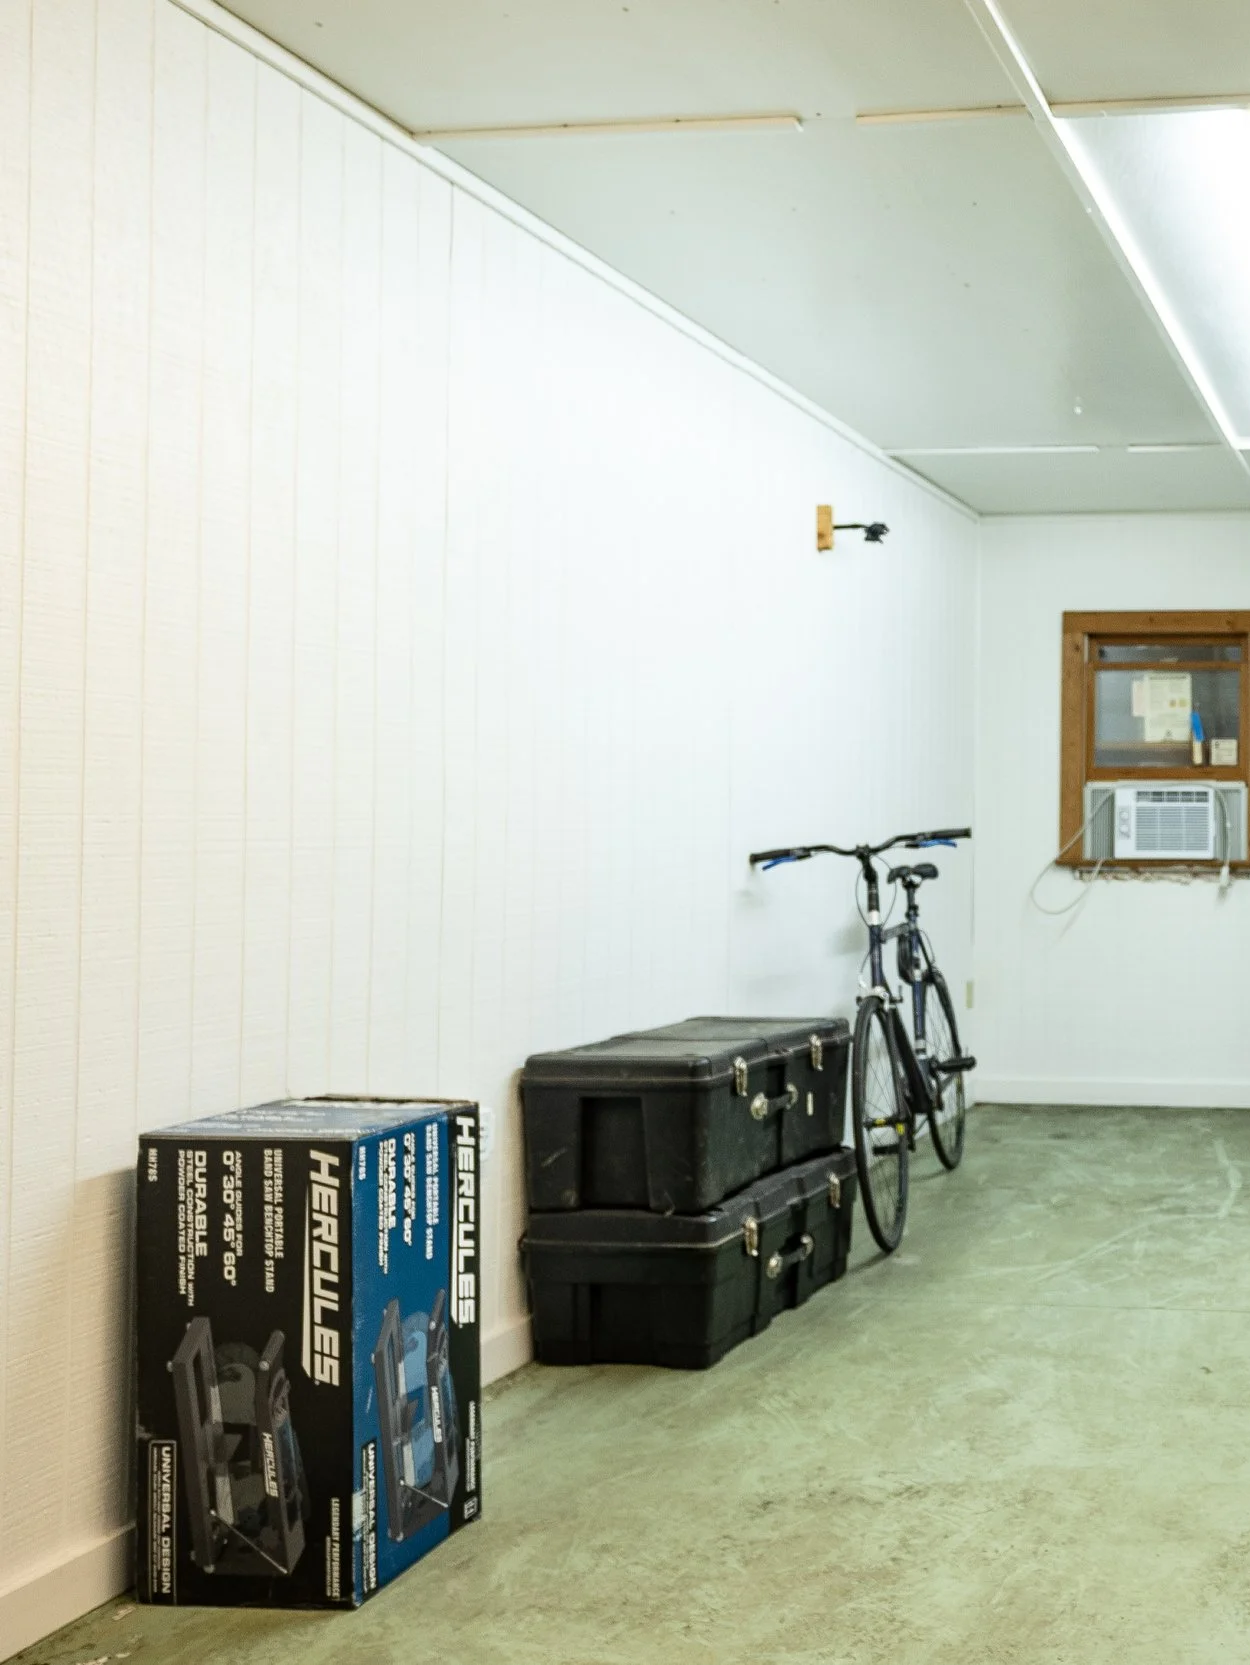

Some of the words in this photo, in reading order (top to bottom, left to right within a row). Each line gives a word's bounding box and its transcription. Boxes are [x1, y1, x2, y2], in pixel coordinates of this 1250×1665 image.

[263, 1149, 272, 1177] BAND
[264, 1179, 273, 1202] SAW
[273, 1149, 283, 1204] UNIVERSAL
[388, 1138, 396, 1229] DURABLE
[195, 1151, 207, 1256] DURABLE
[264, 1205, 273, 1257] BENCHTOP
[457, 1116, 475, 1324] HERCULES
[275, 1207, 283, 1258] PORTABLE
[265, 1260, 274, 1292] STAND
[310, 1150, 340, 1387] HERCULES
[430, 1386, 442, 1443] HERCULES
[162, 1447, 171, 1532] UNIVERSAL
[263, 1433, 279, 1497] HERCULES
[331, 1498, 339, 1541] LEGENDARY
[162, 1536, 171, 1594] DESIGN
[332, 1543, 340, 1597] PERFORMANCE
